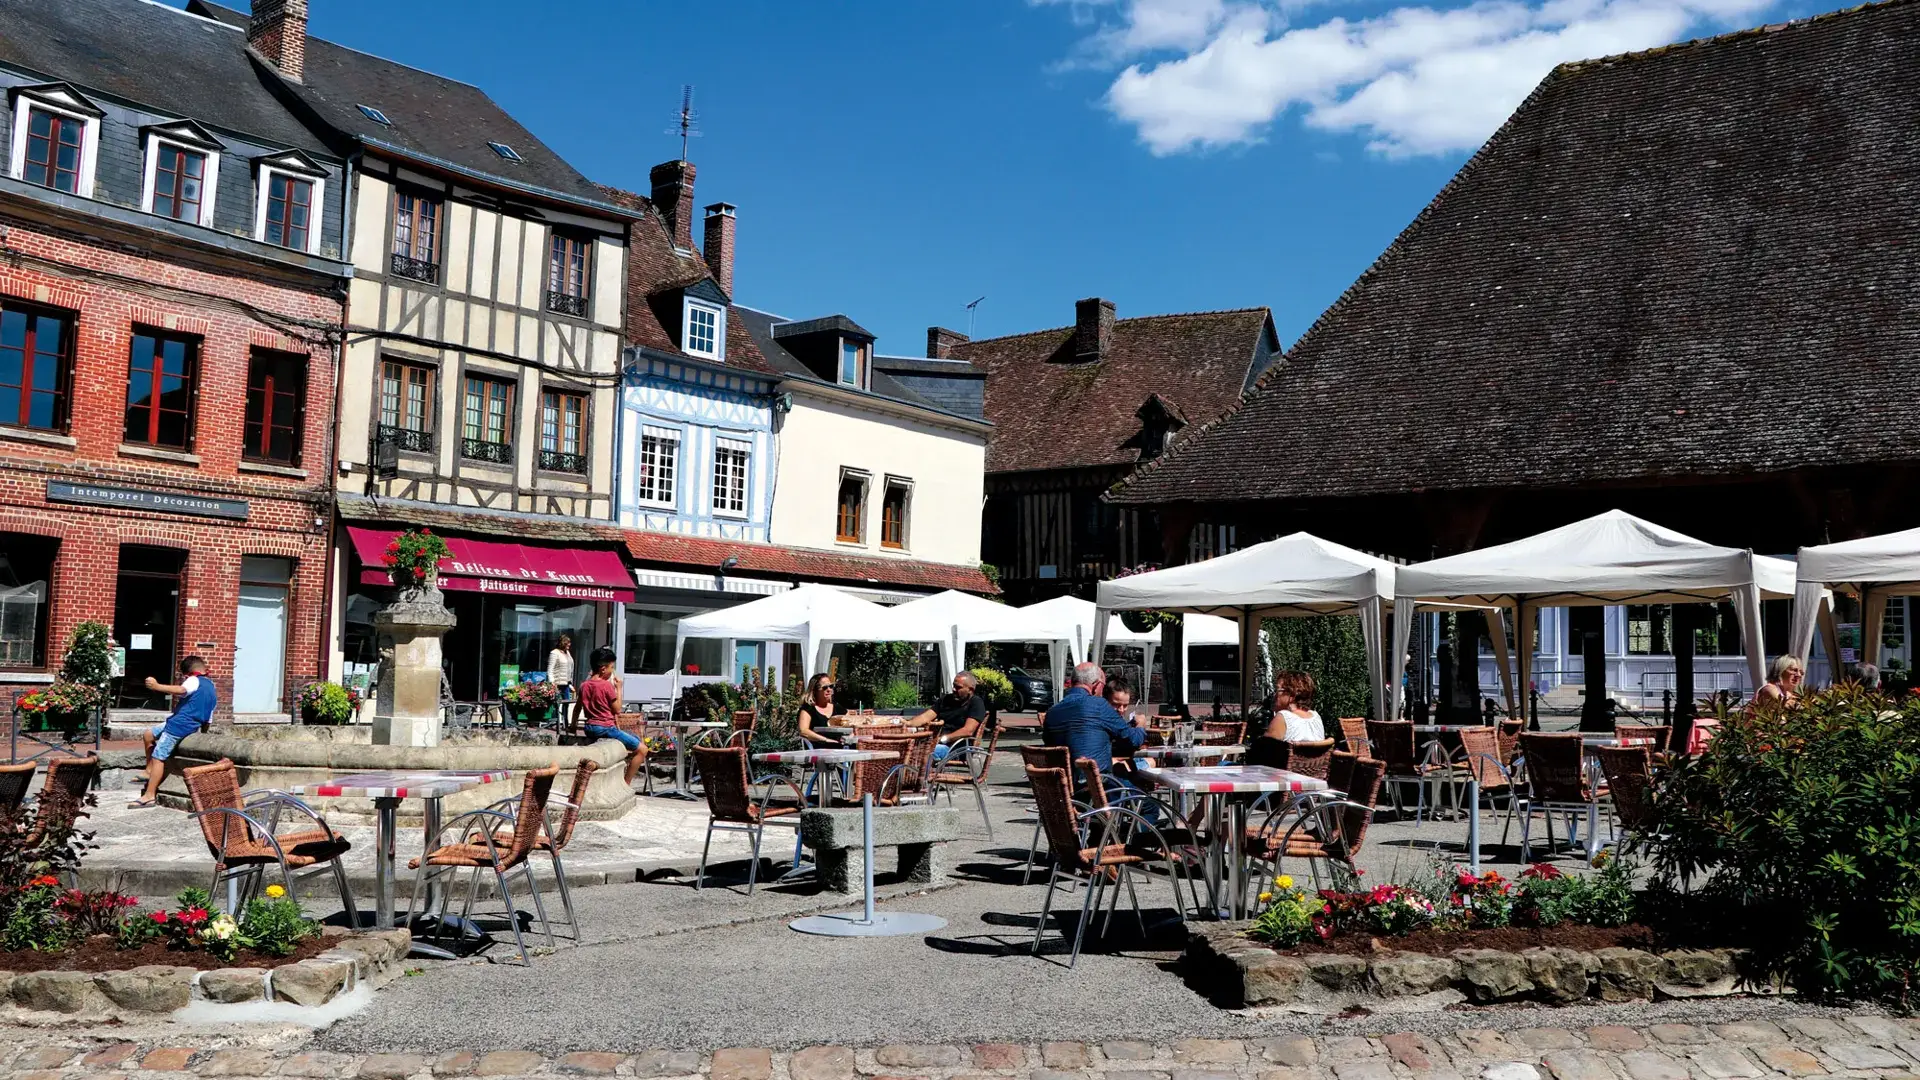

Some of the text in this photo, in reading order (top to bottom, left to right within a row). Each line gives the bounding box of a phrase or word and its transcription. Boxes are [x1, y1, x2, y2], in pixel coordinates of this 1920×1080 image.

[71, 486, 220, 510] Intemporel Décoration
[451, 561, 511, 576] Délices
[519, 567, 539, 579] de
[479, 578, 614, 599] Pâtissier Chocolatier
